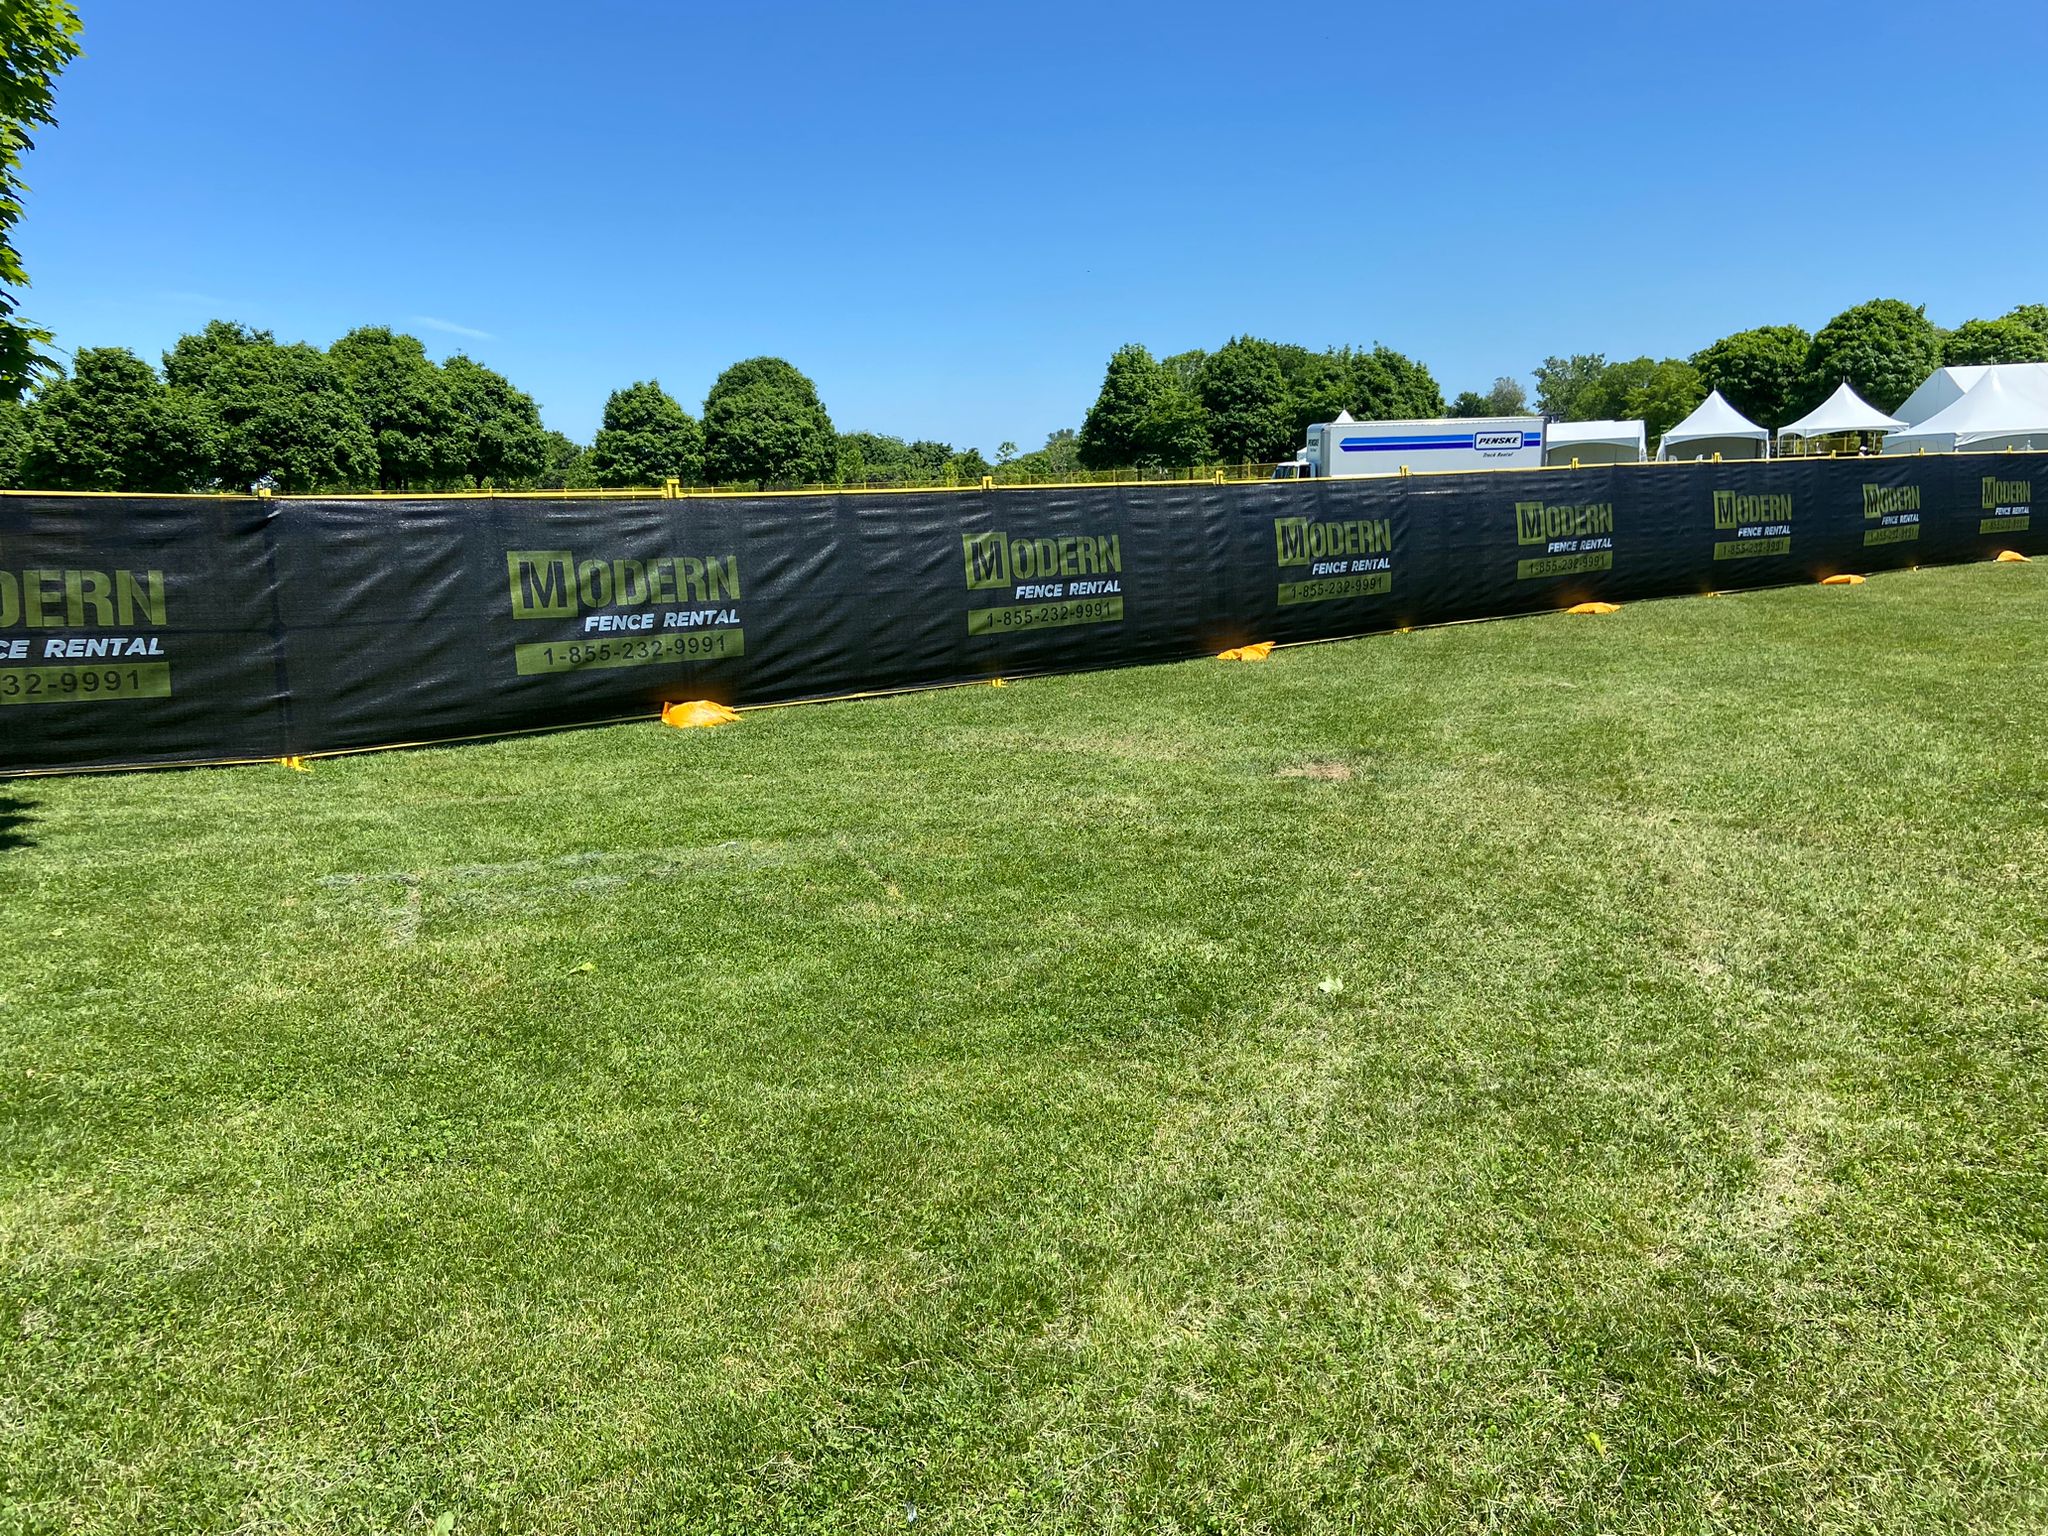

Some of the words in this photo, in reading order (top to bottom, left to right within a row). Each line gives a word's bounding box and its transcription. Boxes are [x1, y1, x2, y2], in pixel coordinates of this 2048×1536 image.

[1478, 436, 1519, 445] PENSKE
[1863, 483, 1921, 519] MODERN
[1982, 476, 2031, 509] MODERN
[1713, 490, 1792, 530] MODERN
[1515, 502, 1613, 545] MODERN
[1737, 527, 1763, 537] FENCE
[1764, 525, 1791, 536] RENTAL
[1274, 517, 1392, 567] MODERN
[1547, 541, 1578, 553] FENCE
[1579, 538, 1612, 551] RENTAL
[962, 532, 1122, 590] MODERN
[1312, 561, 1347, 575] FENCE
[1351, 558, 1391, 572] RENTAL
[507, 550, 741, 619] MODERN
[1015, 584, 1063, 600] FENCE
[1069, 580, 1121, 596] RENTAL
[1291, 577, 1382, 599] 1-855-232-9991
[585, 613, 655, 632] FENCE
[664, 609, 740, 628] RENTAL
[987, 602, 1111, 627] 1-855-232-9991
[44, 637, 165, 658] RENTAL
[543, 635, 725, 665] 1-855-232-9991
